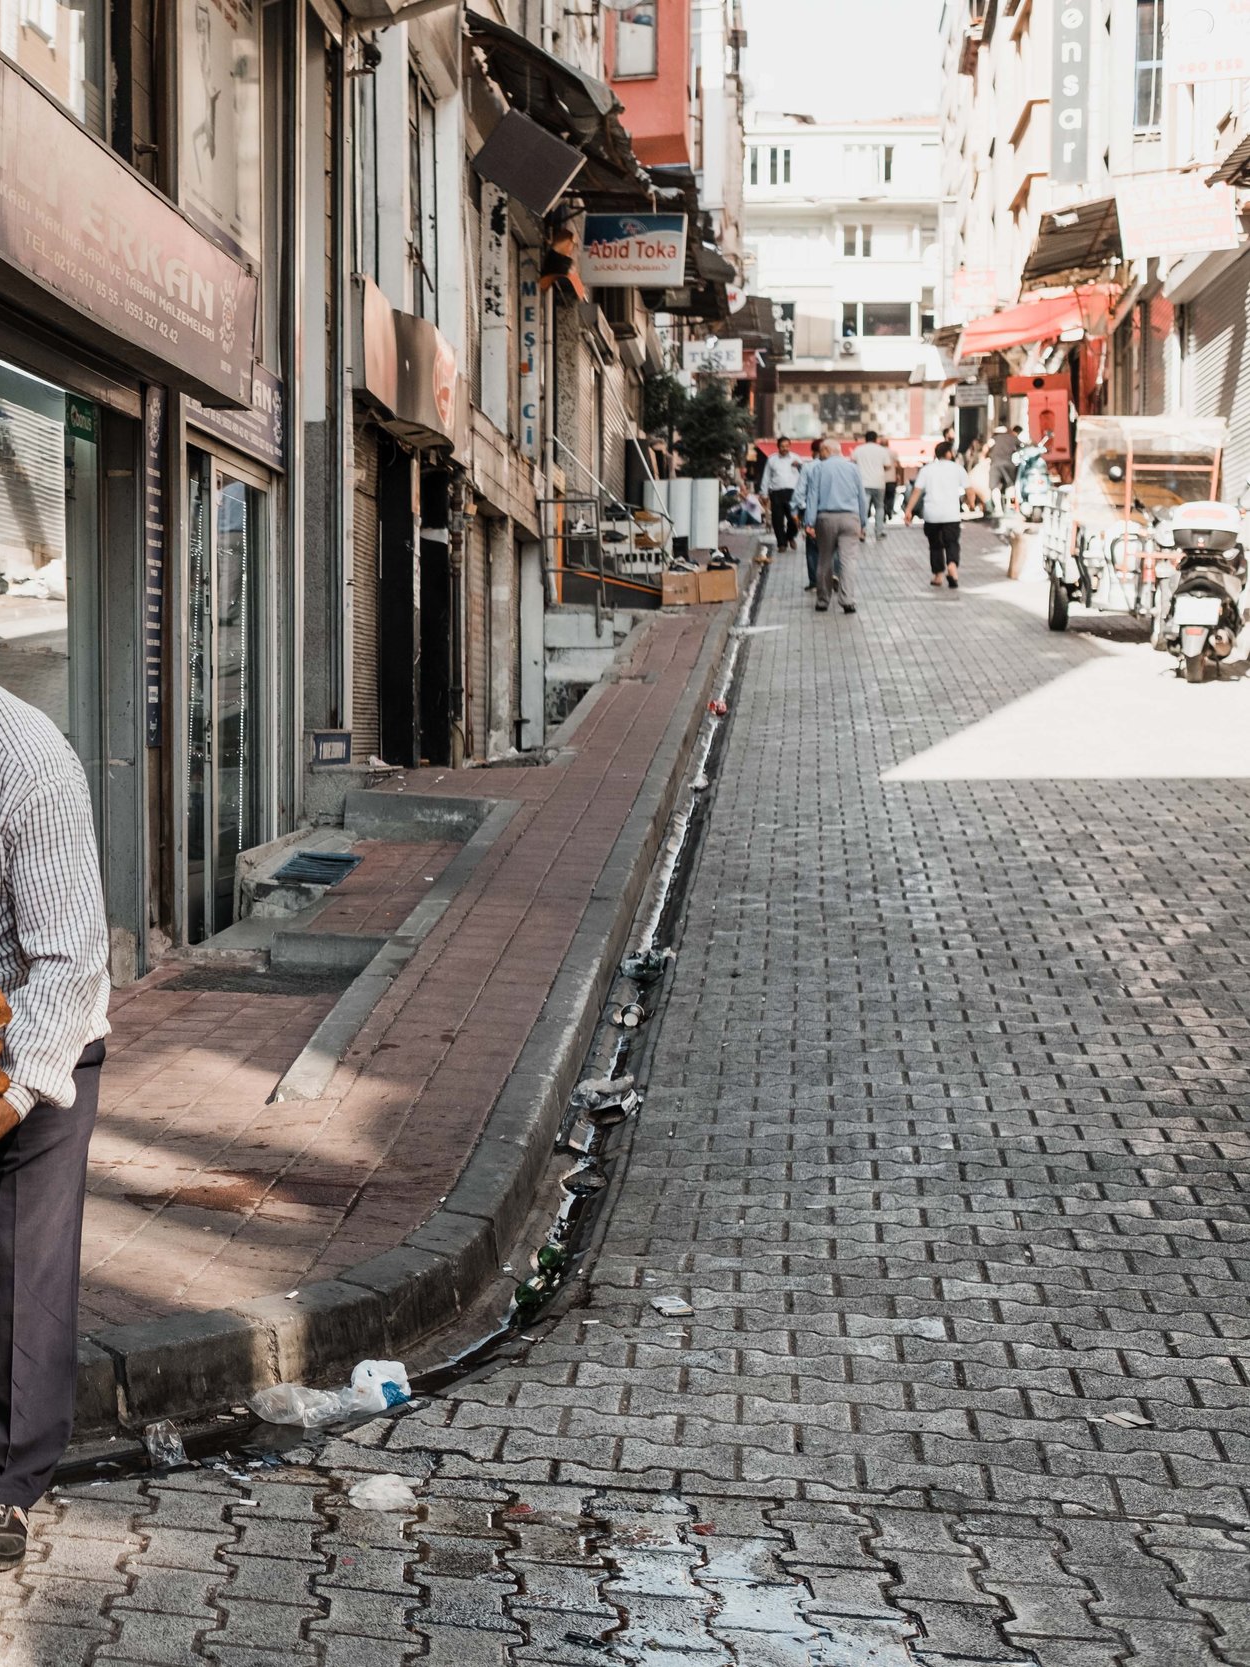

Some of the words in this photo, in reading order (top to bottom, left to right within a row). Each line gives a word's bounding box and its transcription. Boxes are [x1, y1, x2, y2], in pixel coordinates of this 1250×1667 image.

[78, 193, 214, 321] ERKAN
[588, 238, 630, 259] Abid
[635, 240, 678, 259] Toka
[54, 251, 77, 278] 0212
[78, 268, 94, 289] 517
[96, 280, 106, 298] 85
[109, 287, 119, 306] 55
[124, 298, 143, 321] 0553
[144, 311, 158, 330] 327
[159, 321, 168, 338] 42
[169, 327, 179, 344] 42
[110, 262, 122, 280] VE
[125, 271, 156, 304] TABAN
[158, 295, 214, 342] MALZEMELERİ
